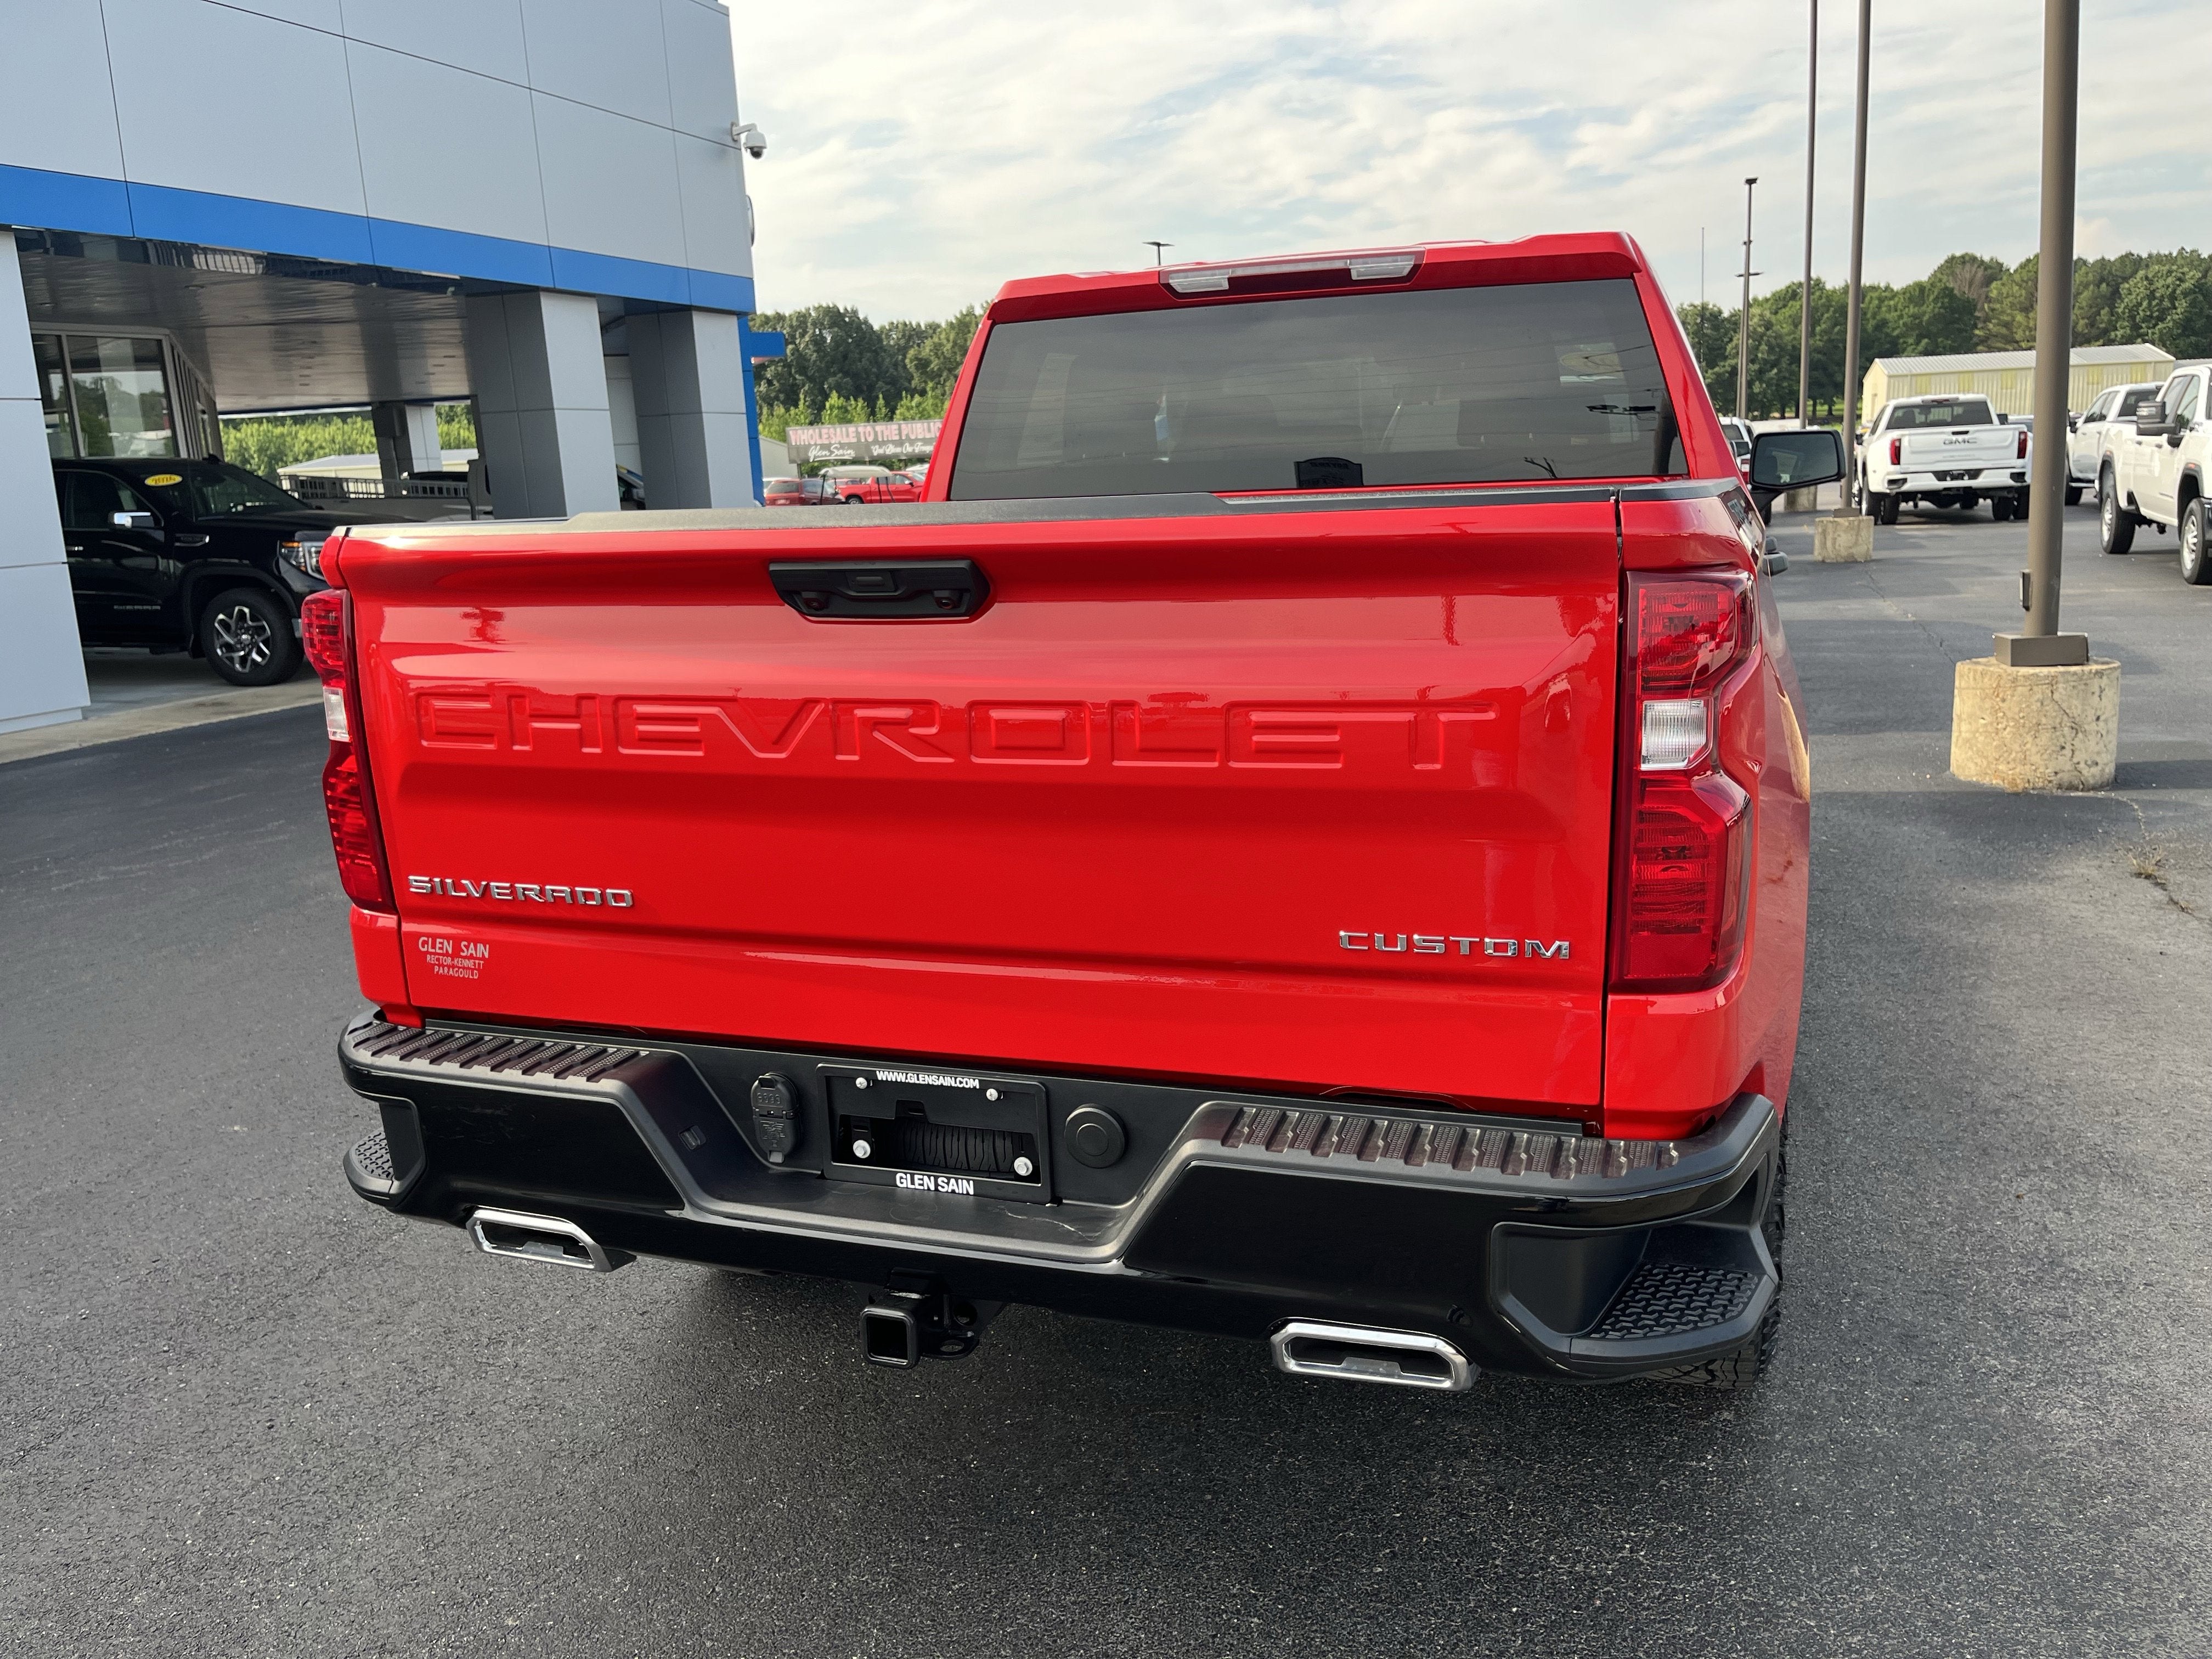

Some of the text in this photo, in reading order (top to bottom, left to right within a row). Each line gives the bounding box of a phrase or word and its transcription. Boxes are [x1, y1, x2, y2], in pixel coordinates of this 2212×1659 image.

[789, 422, 941, 445] WHOLESALE TO THE PUBLIC
[1943, 437, 1978, 445] GMC
[808, 445, 831, 462] Glen
[415, 690, 1500, 770] CHEVROLET
[408, 875, 634, 908] SILVERADO
[418, 936, 490, 959] GLEN SAIN
[1339, 930, 1570, 960] CUSTOM
[426, 954, 484, 970] RECTOR-KENNETT
[433, 966, 479, 980] PARAGOULD
[876, 1070, 980, 1089] WWW.GLENSAIN.COM
[895, 1172, 975, 1195] GLEN SAIN
